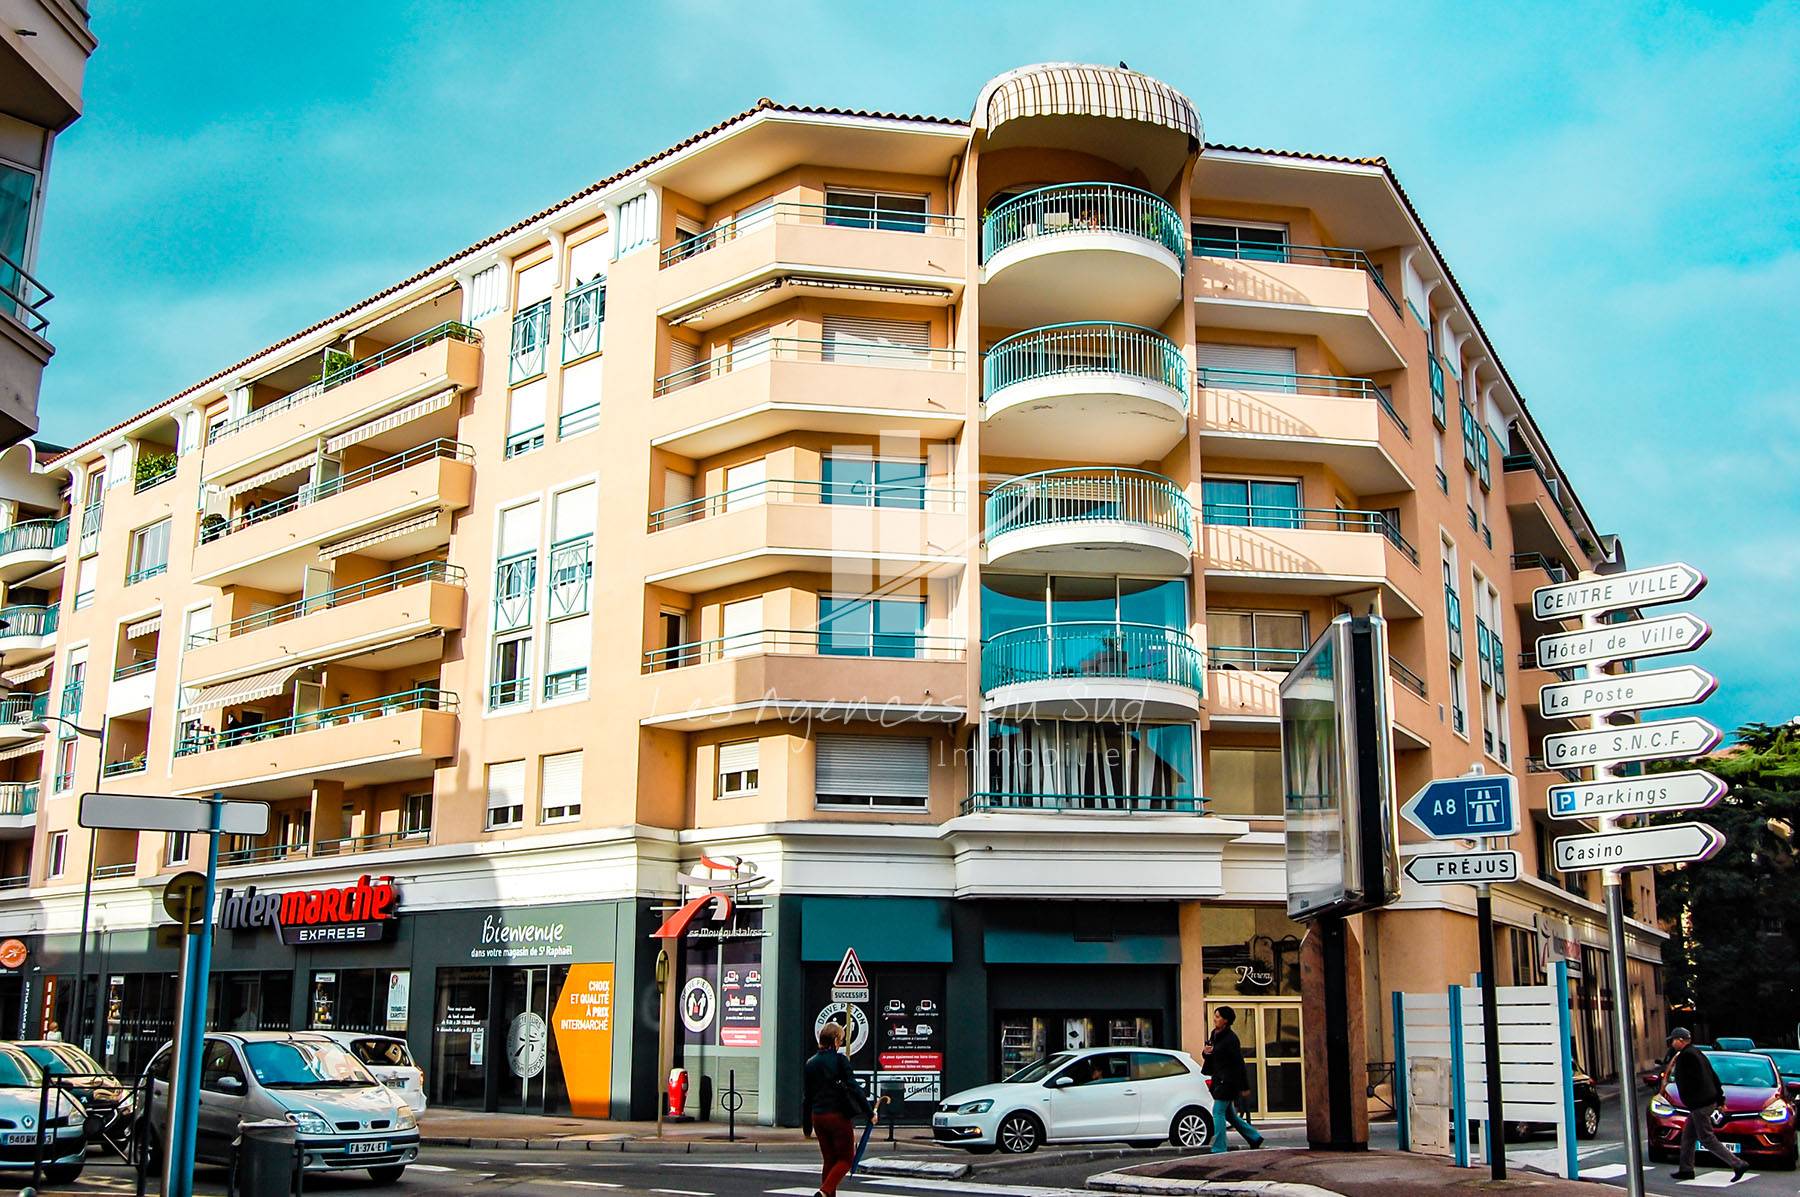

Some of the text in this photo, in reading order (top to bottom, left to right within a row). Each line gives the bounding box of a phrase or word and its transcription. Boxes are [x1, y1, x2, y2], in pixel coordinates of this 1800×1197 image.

[1543, 574, 1678, 610] CENTRE VILLE
[1547, 625, 1685, 660] Hôtel de Ville
[1550, 687, 1634, 708] La Poste
[1556, 730, 1686, 758] Gare S.N.C.F.
[1584, 787, 1667, 807] Parkings
[1433, 798, 1457, 816] A8
[1564, 844, 1623, 861] Casino
[1436, 858, 1509, 876] FRÉJUS
[299, 927, 366, 941] EXPRESS
[481, 914, 564, 944] Bienvenue
[471, 948, 486, 958] dans
[486, 948, 502, 957] votre
[503, 946, 529, 959] magasin
[529, 946, 538, 956] de
[546, 945, 573, 958] Raphaël
[588, 981, 610, 991] CHOIX
[834, 991, 867, 999] SUCCESSIFS
[571, 991, 609, 1004] ET QUALITÉ
[592, 1007, 609, 1017] PRIX
[817, 1003, 866, 1025] DRIVE PTON
[560, 1018, 609, 1031] INTERMARCHÉ
